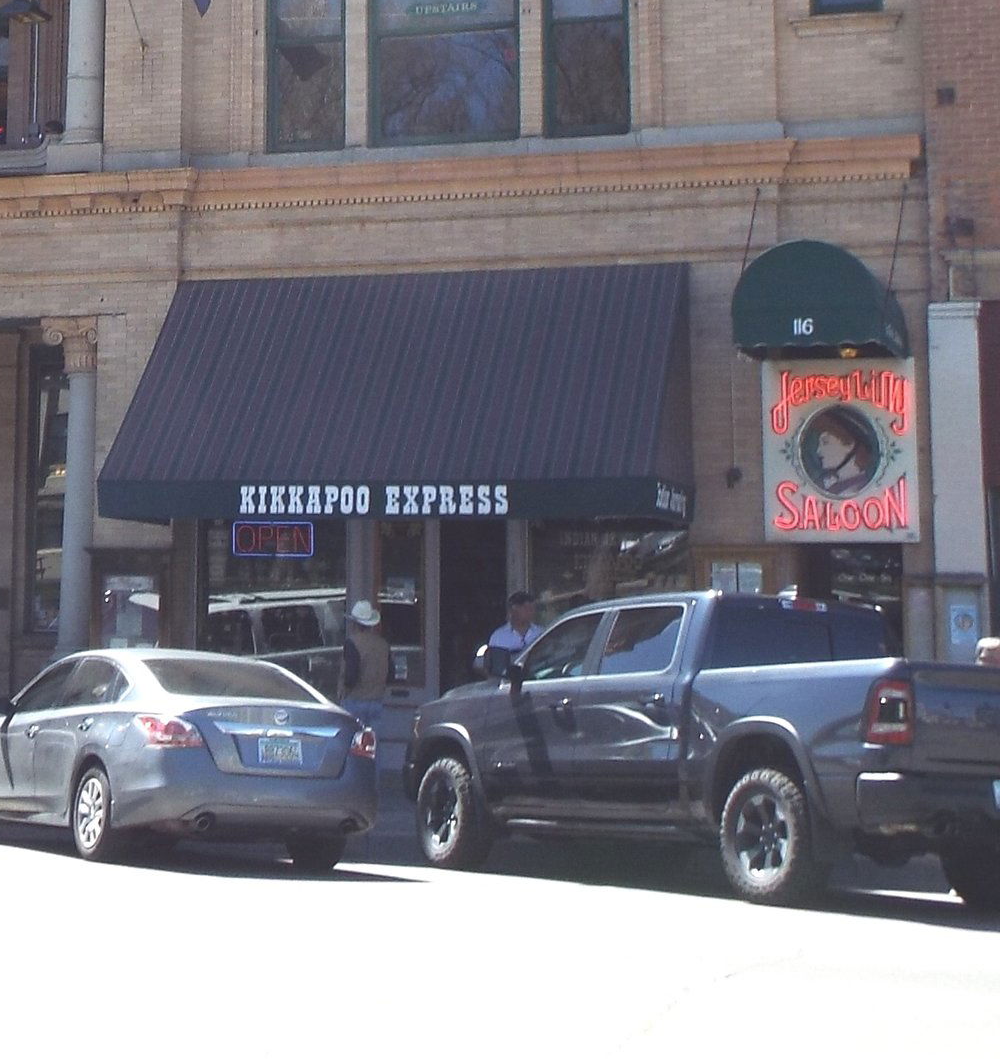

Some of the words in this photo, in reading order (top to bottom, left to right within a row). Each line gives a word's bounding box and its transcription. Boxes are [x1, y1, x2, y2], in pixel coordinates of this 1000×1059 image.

[793, 318, 814, 335] 116
[771, 370, 851, 435] Jersey
[239, 485, 370, 515] KIKKAPOO
[385, 485, 509, 515] EXPRESS
[775, 476, 908, 532] SALOON
[236, 524, 311, 553] OPEN
